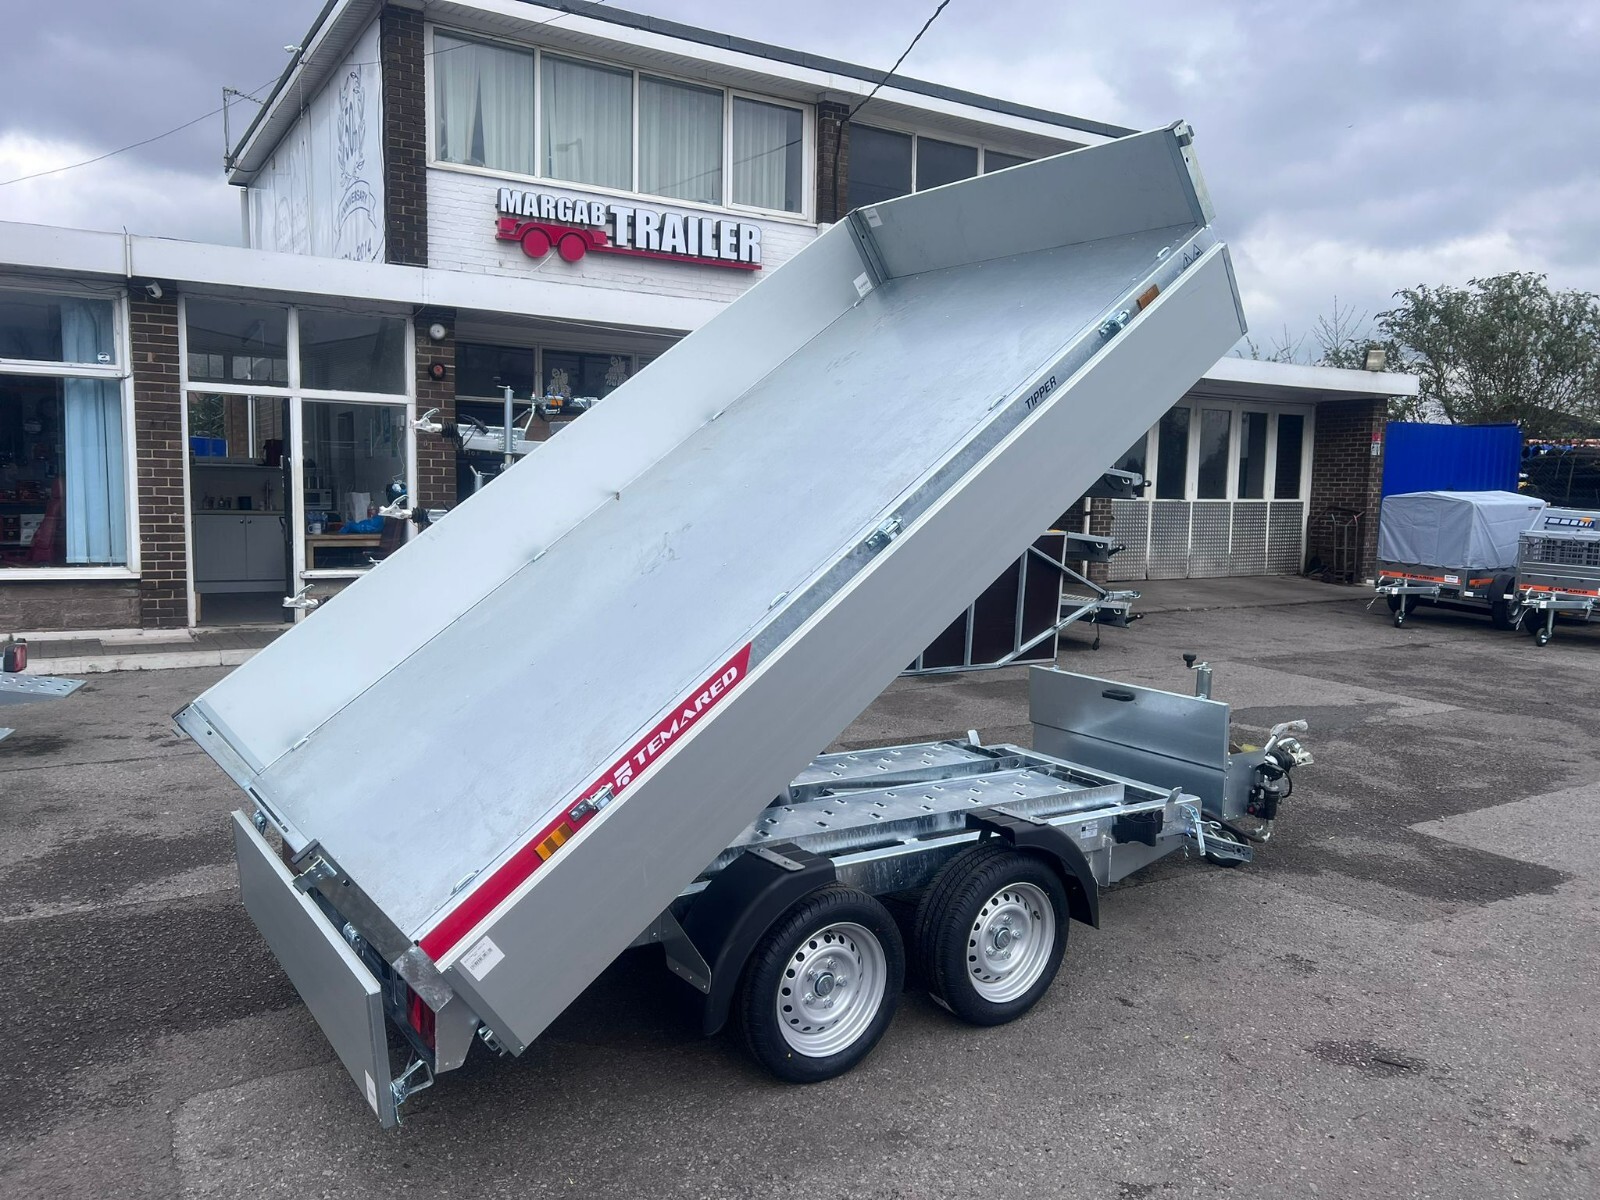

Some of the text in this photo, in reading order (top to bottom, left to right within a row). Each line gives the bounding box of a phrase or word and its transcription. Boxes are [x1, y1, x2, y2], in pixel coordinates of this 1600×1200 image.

[499, 188, 762, 263] MARGAB TRAILER
[1025, 375, 1057, 410] TIPPER
[633, 666, 738, 765] TEMARED
